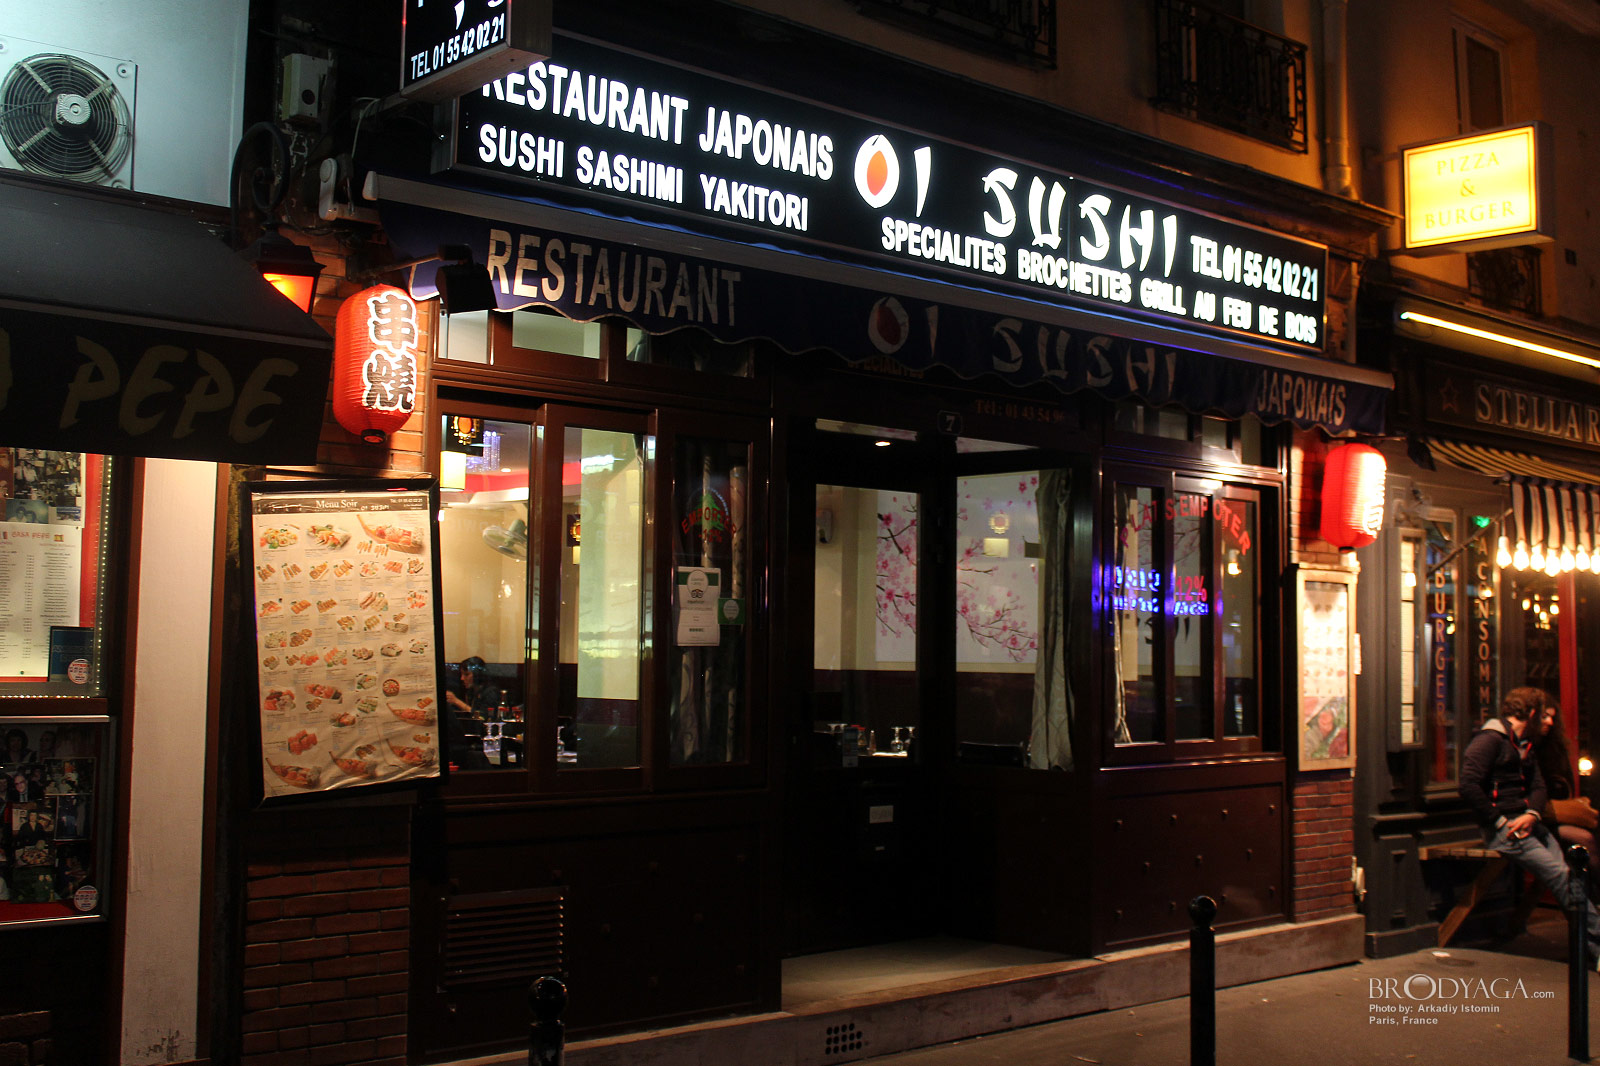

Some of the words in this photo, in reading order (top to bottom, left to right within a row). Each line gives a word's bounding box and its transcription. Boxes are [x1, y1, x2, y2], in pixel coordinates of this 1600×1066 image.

[411, 51, 430, 79] TEL
[433, 42, 444, 70] 01
[447, 35, 460, 63] 55
[461, 28, 475, 56] 42
[476, 21, 490, 50] 02
[491, 13, 504, 43] 21
[478, 123, 564, 178] SUSHI
[576, 146, 683, 203] SASHIMI
[699, 174, 809, 231] YAKITORI
[699, 107, 834, 181] JAPONAIS
[1437, 151, 1500, 176] PIZZA
[1425, 200, 1515, 229] BURGER
[1460, 178, 1477, 197] &
[982, 167, 1178, 277] SUSHI
[487, 228, 741, 326] RESTAURANT
[881, 215, 1007, 275] SPECIALITES
[1017, 250, 1132, 304] BROCHETTES
[1140, 277, 1186, 316] GRILL
[1193, 290, 1215, 322] AU
[1223, 296, 1251, 329] FEU
[1259, 304, 1278, 335] DE
[1285, 311, 1316, 344] BOIS
[1190, 235, 1222, 278] TEL
[1223, 244, 1241, 283] 01
[1243, 250, 1262, 288] 55
[1263, 256, 1281, 292] 42
[1283, 261, 1300, 297] 02
[1301, 266, 1317, 301] 21
[59, 335, 299, 444] PEPE
[993, 316, 1177, 398] SUSHI
[944, 417, 956, 432] 7
[1257, 369, 1347, 425] JAPONAIS
[1476, 384, 1600, 444] STELLAR
[316, 500, 340, 508] Menu
[341, 499, 359, 508] Soir
[1120, 499, 1175, 548] PLATS
[1434, 567, 1447, 726] BURGER
